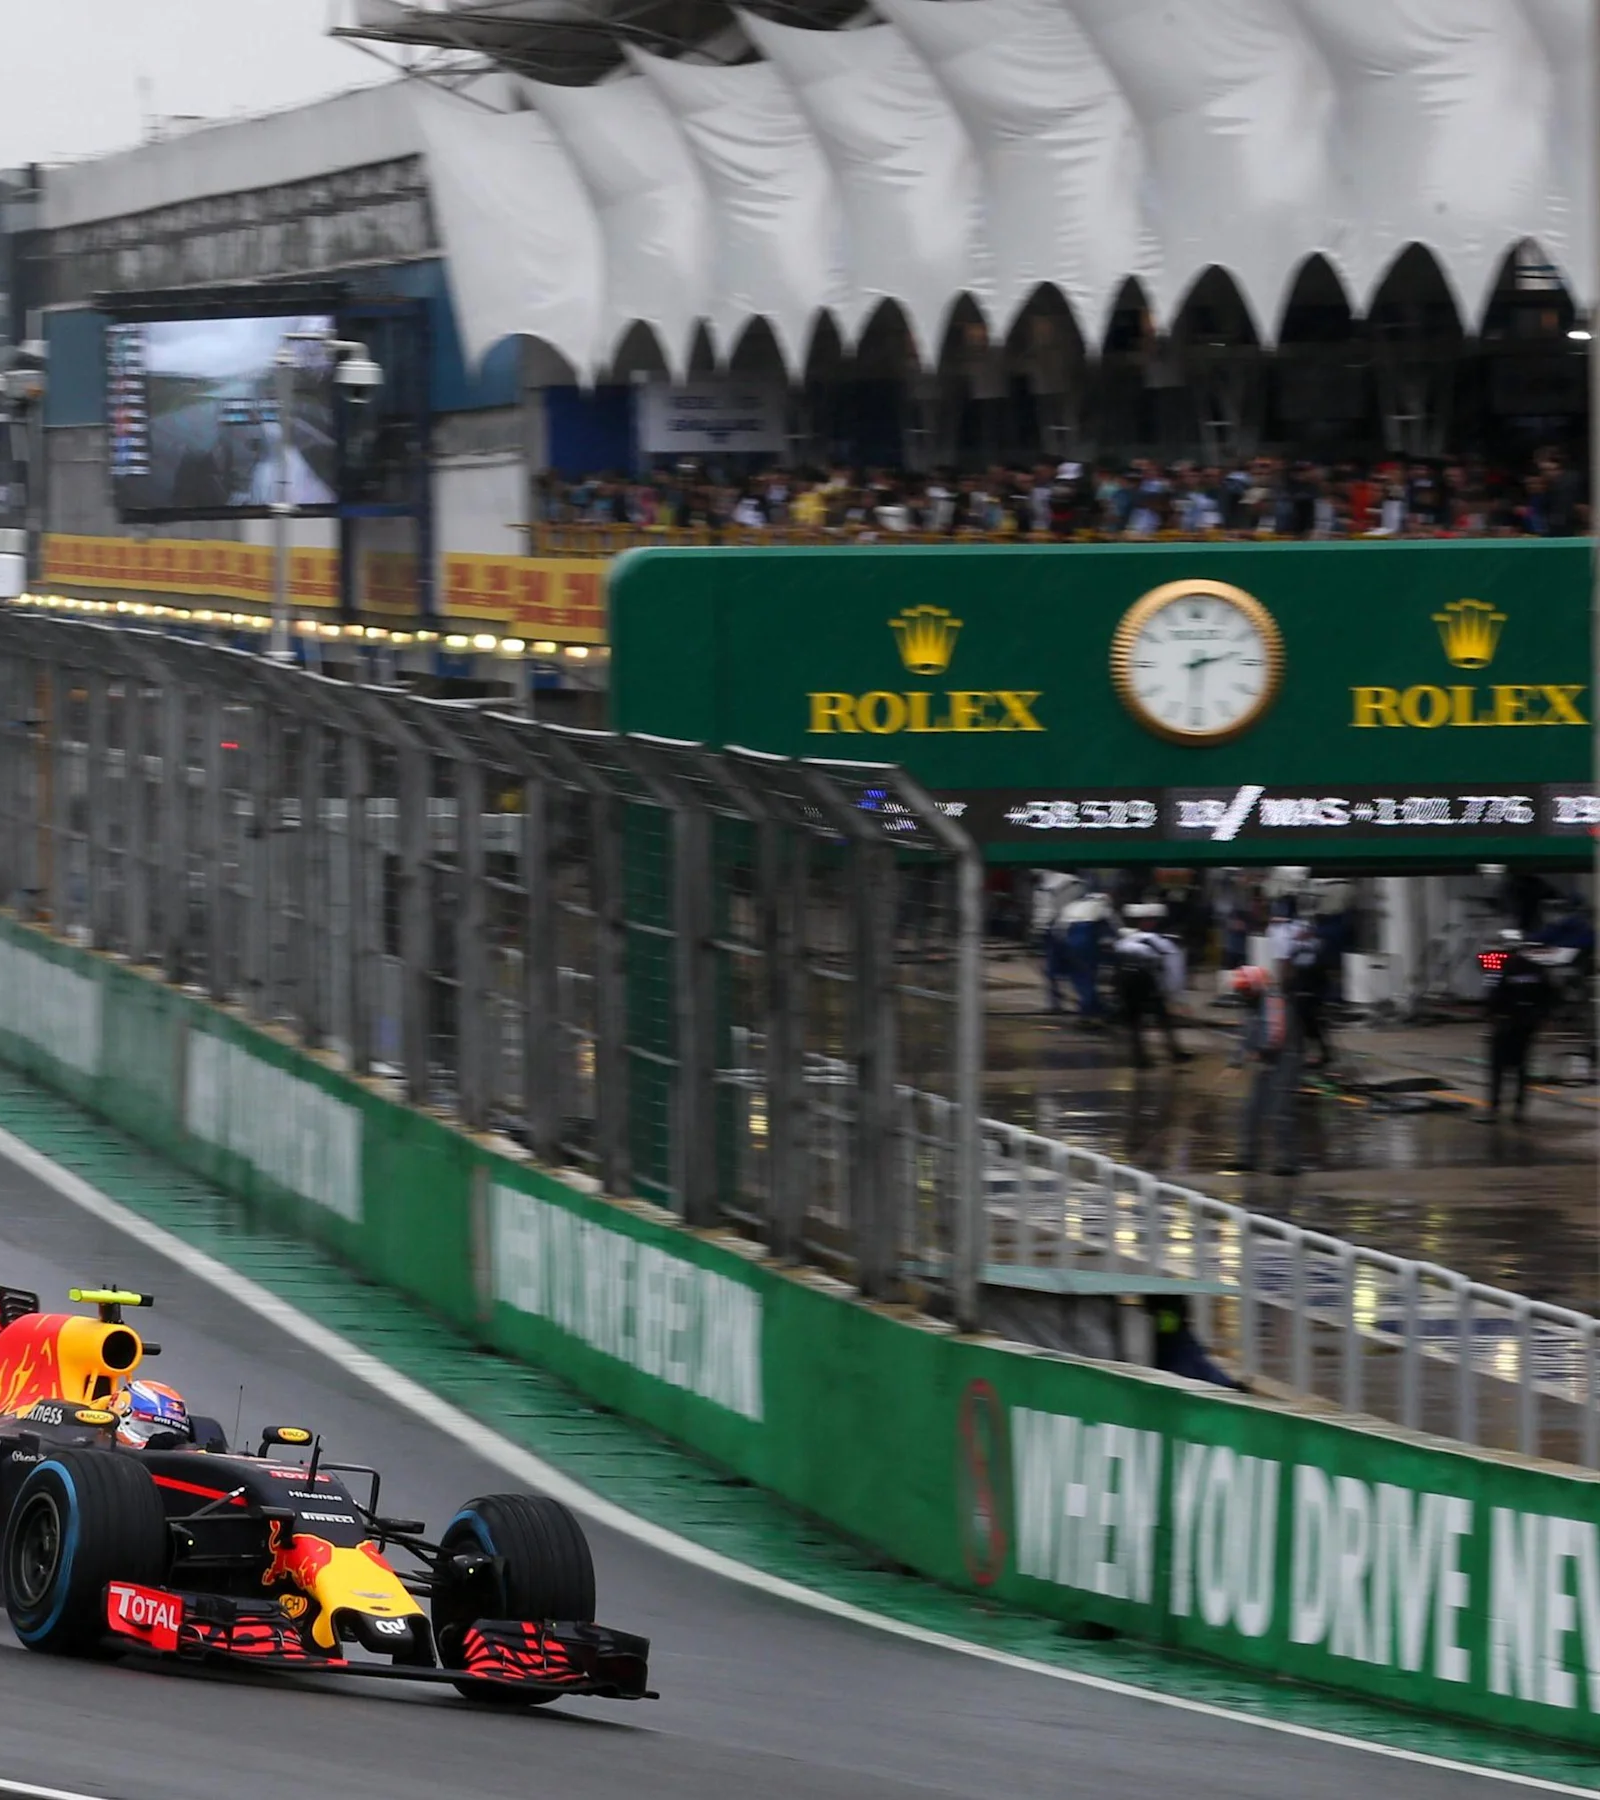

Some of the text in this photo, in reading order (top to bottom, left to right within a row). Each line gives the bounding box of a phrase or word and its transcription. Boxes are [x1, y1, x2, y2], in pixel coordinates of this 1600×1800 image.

[805, 691, 1048, 734] ROLEX
[1348, 684, 1592, 728] ROLEX
[24, 1405, 63, 1426] xness
[288, 1490, 343, 1502] Hisense
[1010, 1405, 1161, 1603] WHEN
[1171, 1438, 1281, 1637] YOU
[1288, 1463, 1473, 1683] DRIVE
[110, 1586, 179, 1632] TOTAL
